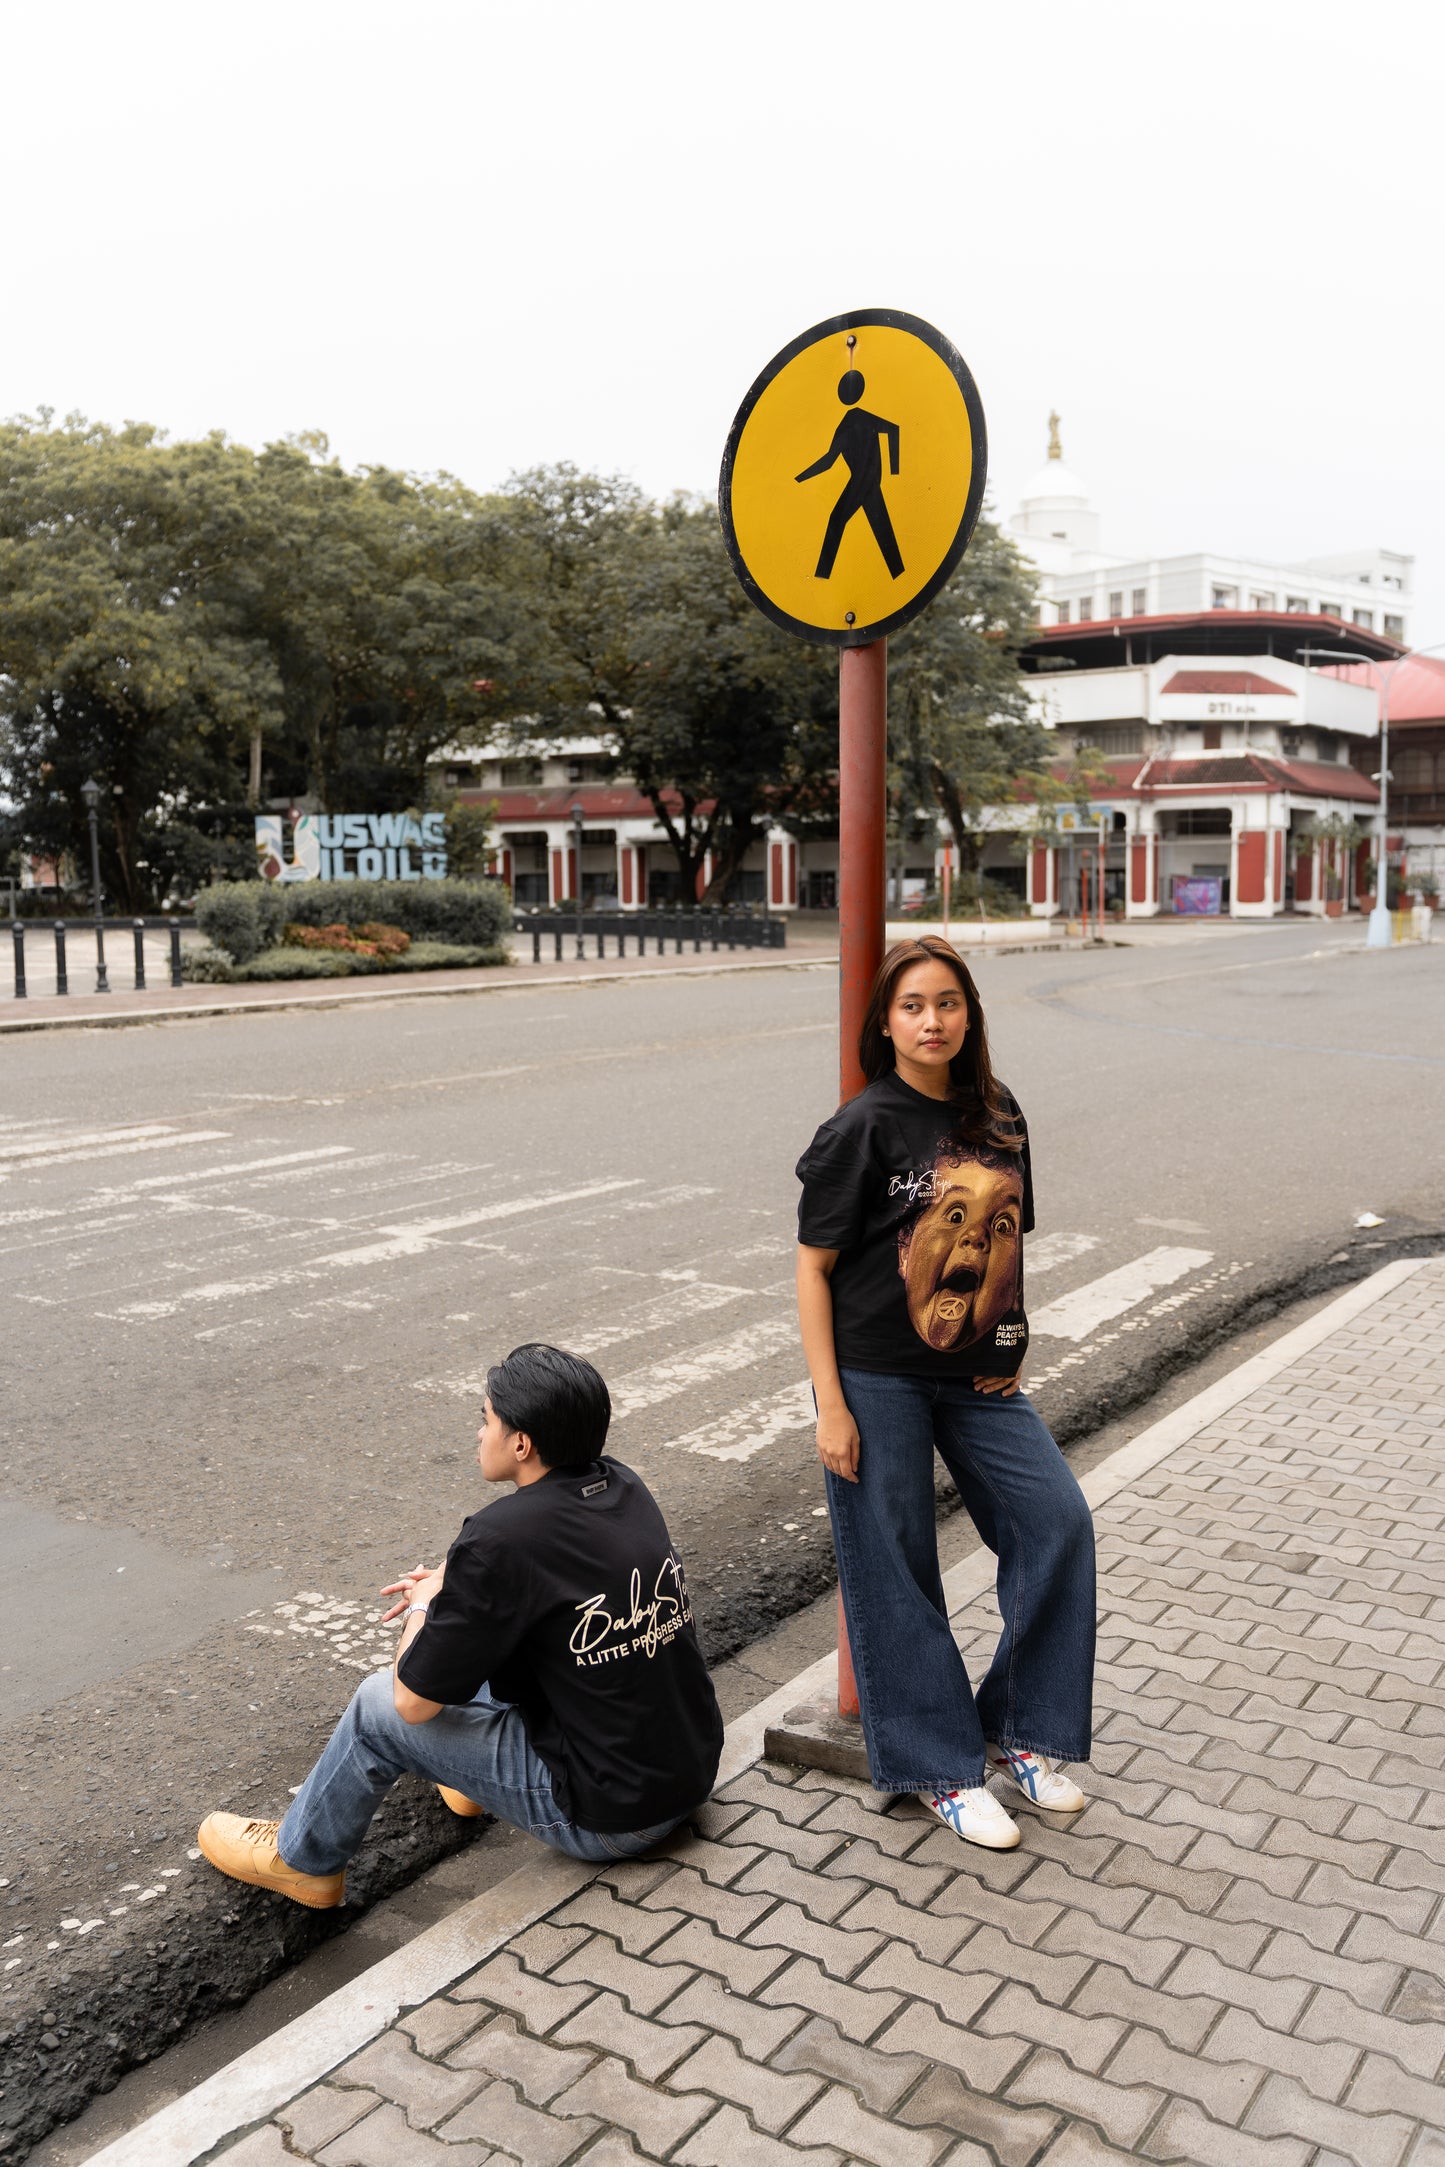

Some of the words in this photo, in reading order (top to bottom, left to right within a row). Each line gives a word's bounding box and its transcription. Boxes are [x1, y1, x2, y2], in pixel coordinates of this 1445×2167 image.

[996, 1331, 1018, 1339] PEACE
[995, 1338, 1017, 1346] CHAOS
[576, 1655, 587, 1667] A
[588, 1643, 630, 1667] LITTE
[631, 1614, 684, 1652] PROGRESS
